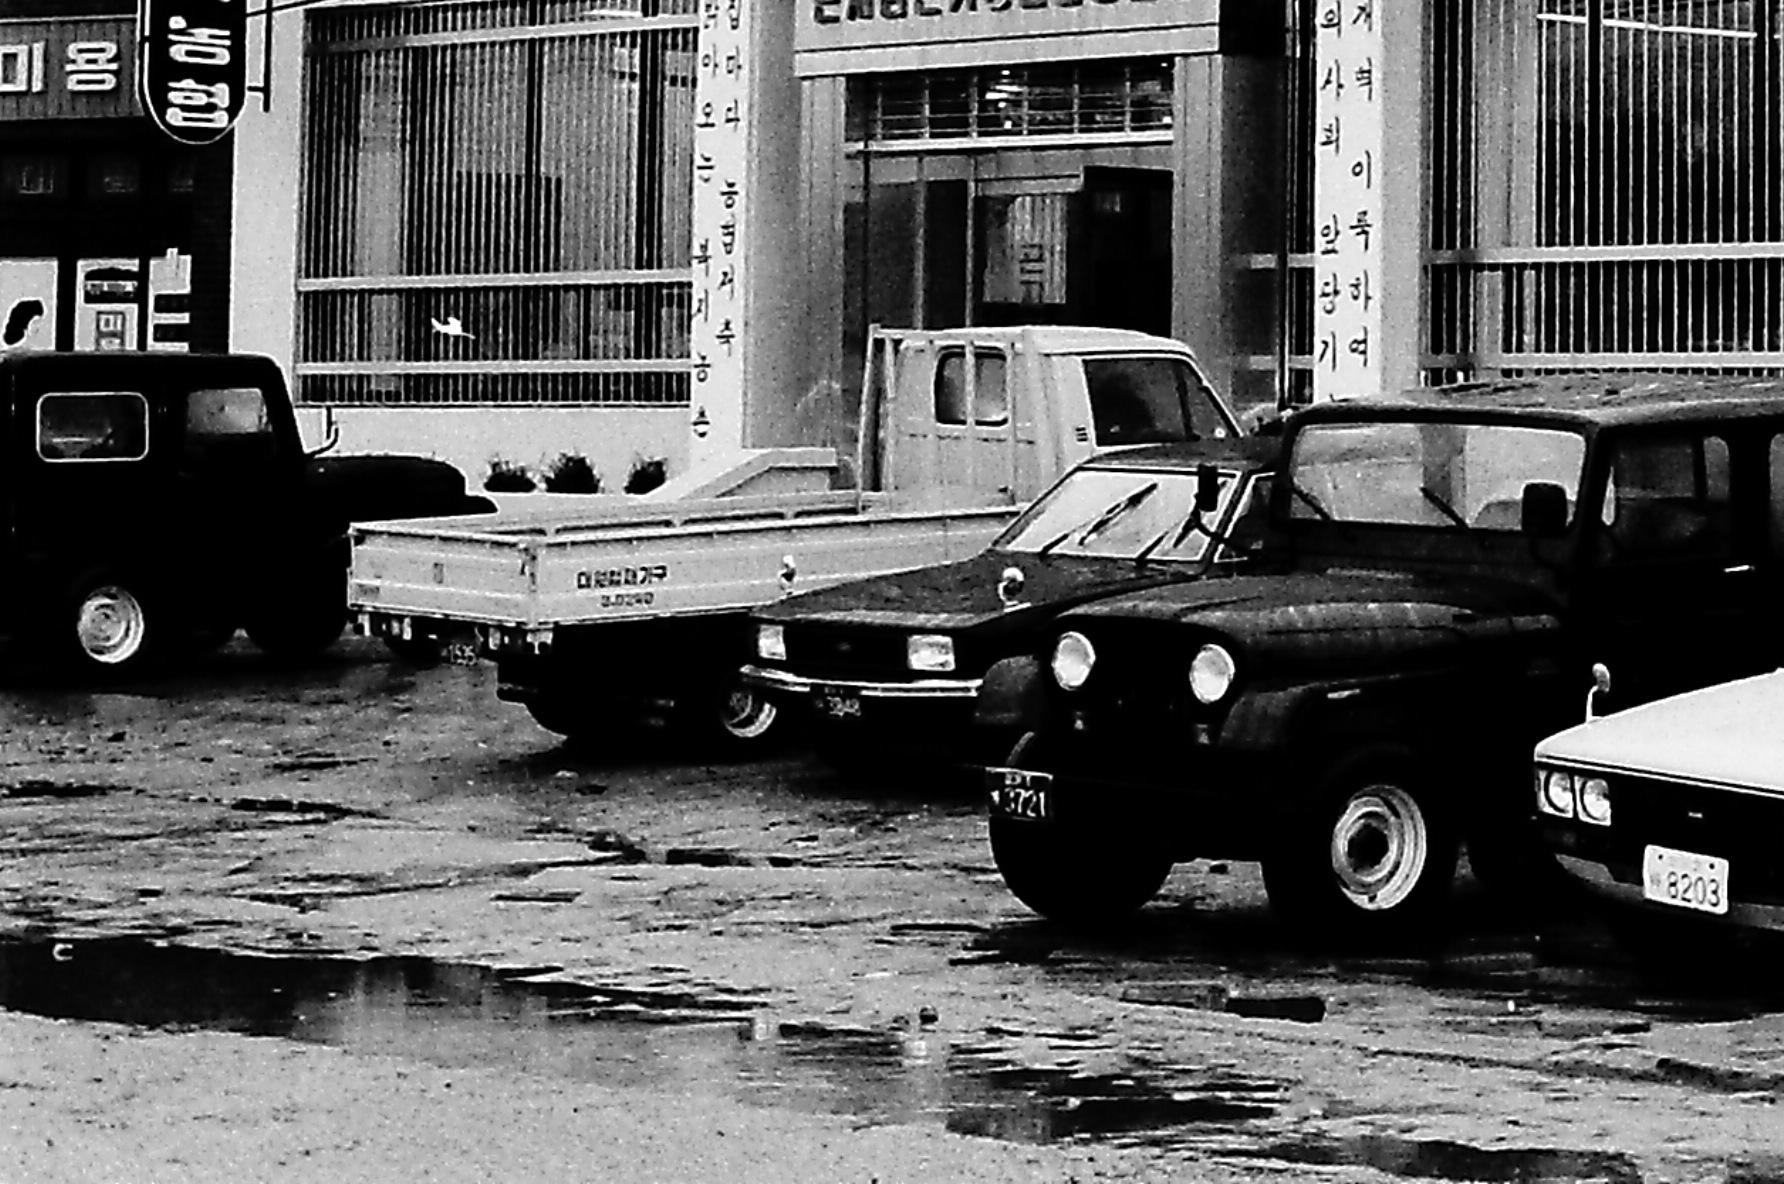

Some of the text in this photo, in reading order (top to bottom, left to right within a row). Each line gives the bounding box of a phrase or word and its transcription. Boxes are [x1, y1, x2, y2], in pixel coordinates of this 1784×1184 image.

[1317, 213, 1352, 402] 앞당기
[1004, 787, 1046, 818] 3721
[1666, 870, 1721, 908] 8203
